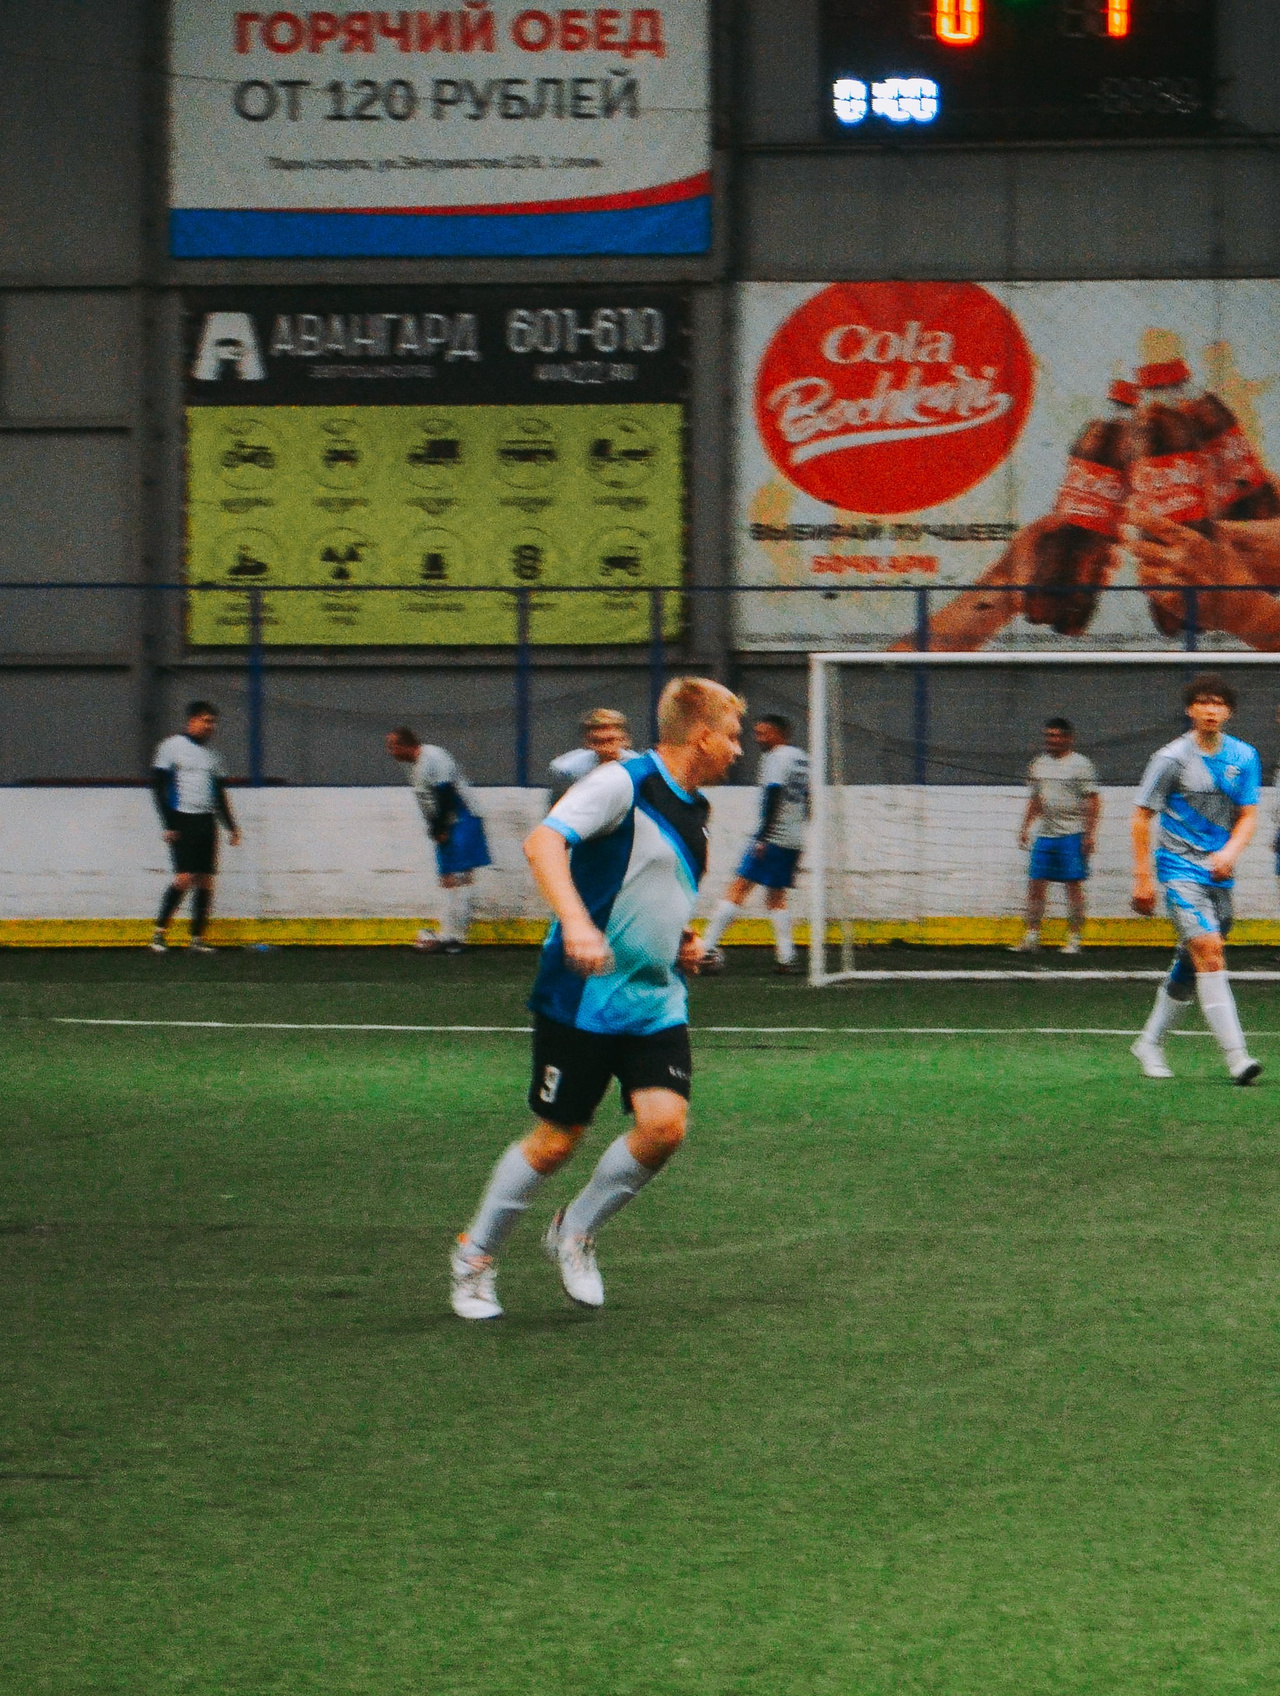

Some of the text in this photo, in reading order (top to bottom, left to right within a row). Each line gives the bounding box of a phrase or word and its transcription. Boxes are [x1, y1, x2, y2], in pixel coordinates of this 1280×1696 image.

[234, 1, 666, 57] ГОРЯЧИЙ ОБЕД
[233, 69, 640, 122] ОТ 120 РУБЛЕЙ
[270, 312, 483, 362] АВАНГАРД
[507, 307, 666, 354] 601-610
[821, 320, 954, 364] Cola
